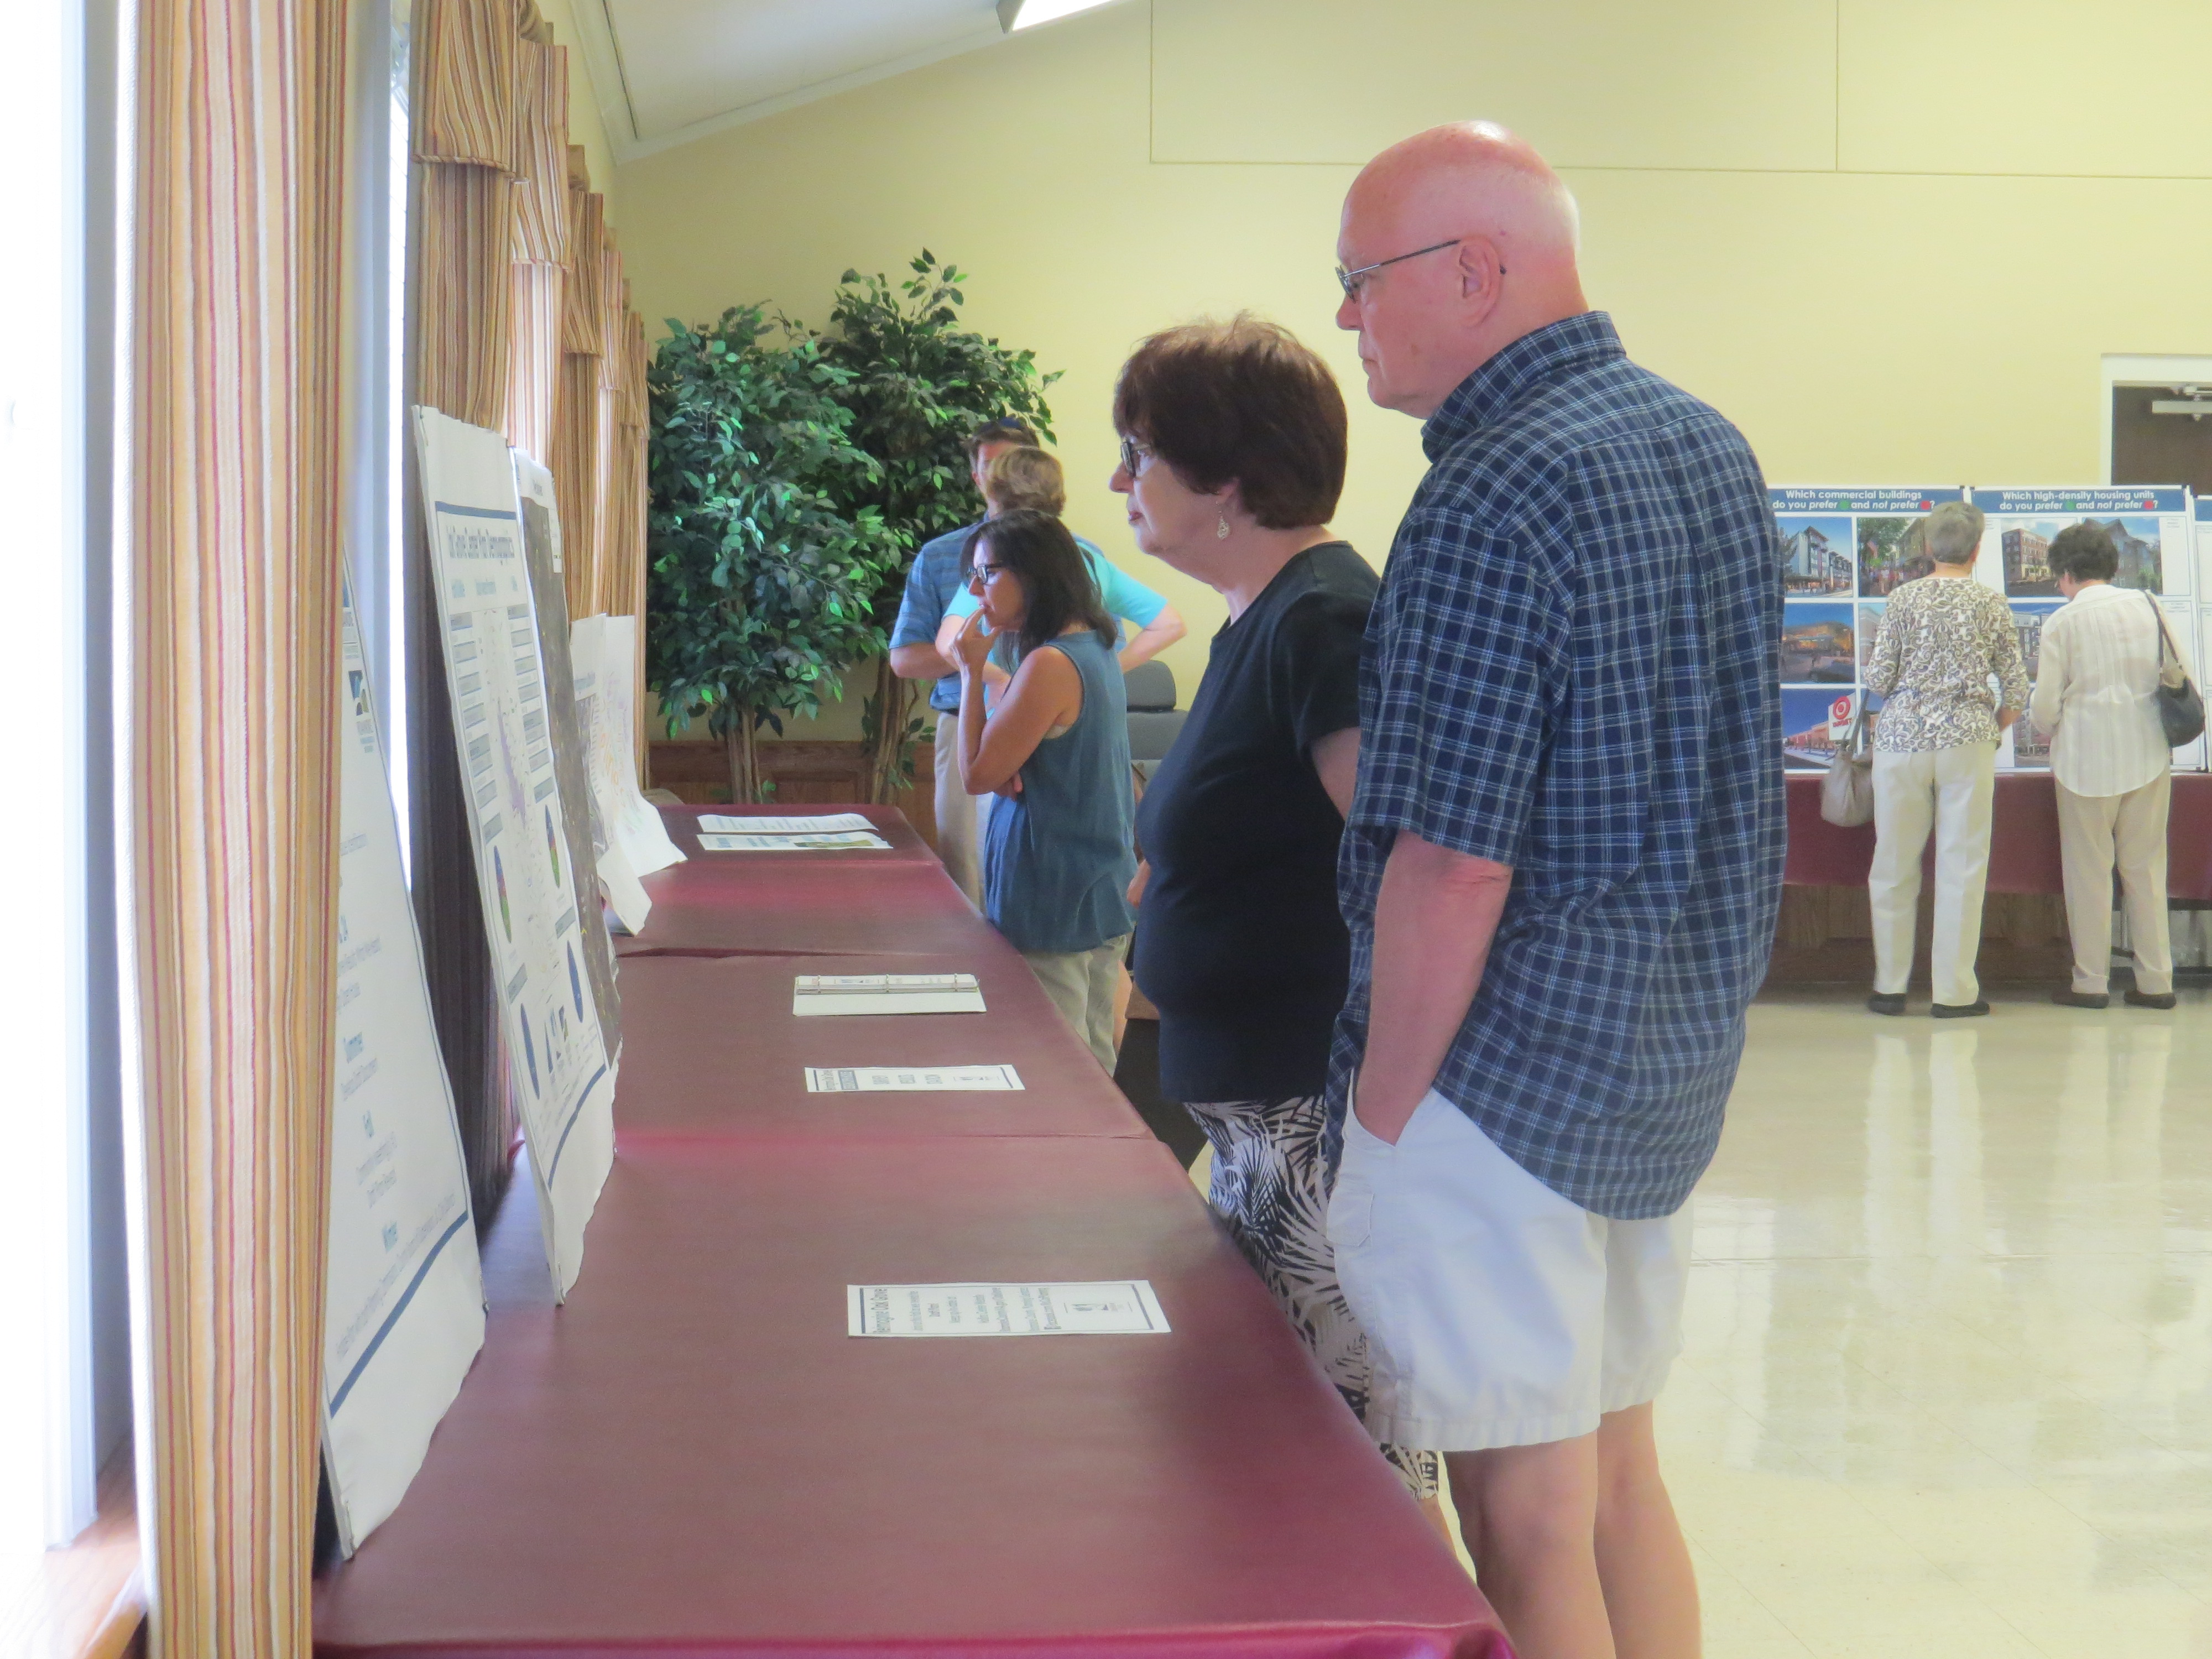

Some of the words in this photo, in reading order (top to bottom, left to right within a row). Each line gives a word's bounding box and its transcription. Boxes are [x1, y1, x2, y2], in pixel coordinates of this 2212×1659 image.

[1786, 490, 1815, 499] Which
[1819, 490, 1876, 499] commercial
[1879, 490, 1922, 501] buildings
[2002, 491, 2032, 500] Which
[2033, 491, 2092, 502] high-density
[2094, 490, 2131, 501] housing
[2133, 490, 2154, 499] units
[1772, 500, 1786, 509] do
[1788, 502, 1807, 510] you
[1809, 500, 1838, 510] prefer
[1851, 500, 1870, 509] and
[1872, 500, 1888, 509] not
[1890, 500, 1919, 510] prefer
[1999, 502, 2012, 510] do
[2015, 503, 2032, 512] you
[2034, 501, 2063, 512] prefer
[2076, 501, 2095, 509] and
[2097, 500, 2112, 509] not
[2114, 500, 2143, 510] prefer
